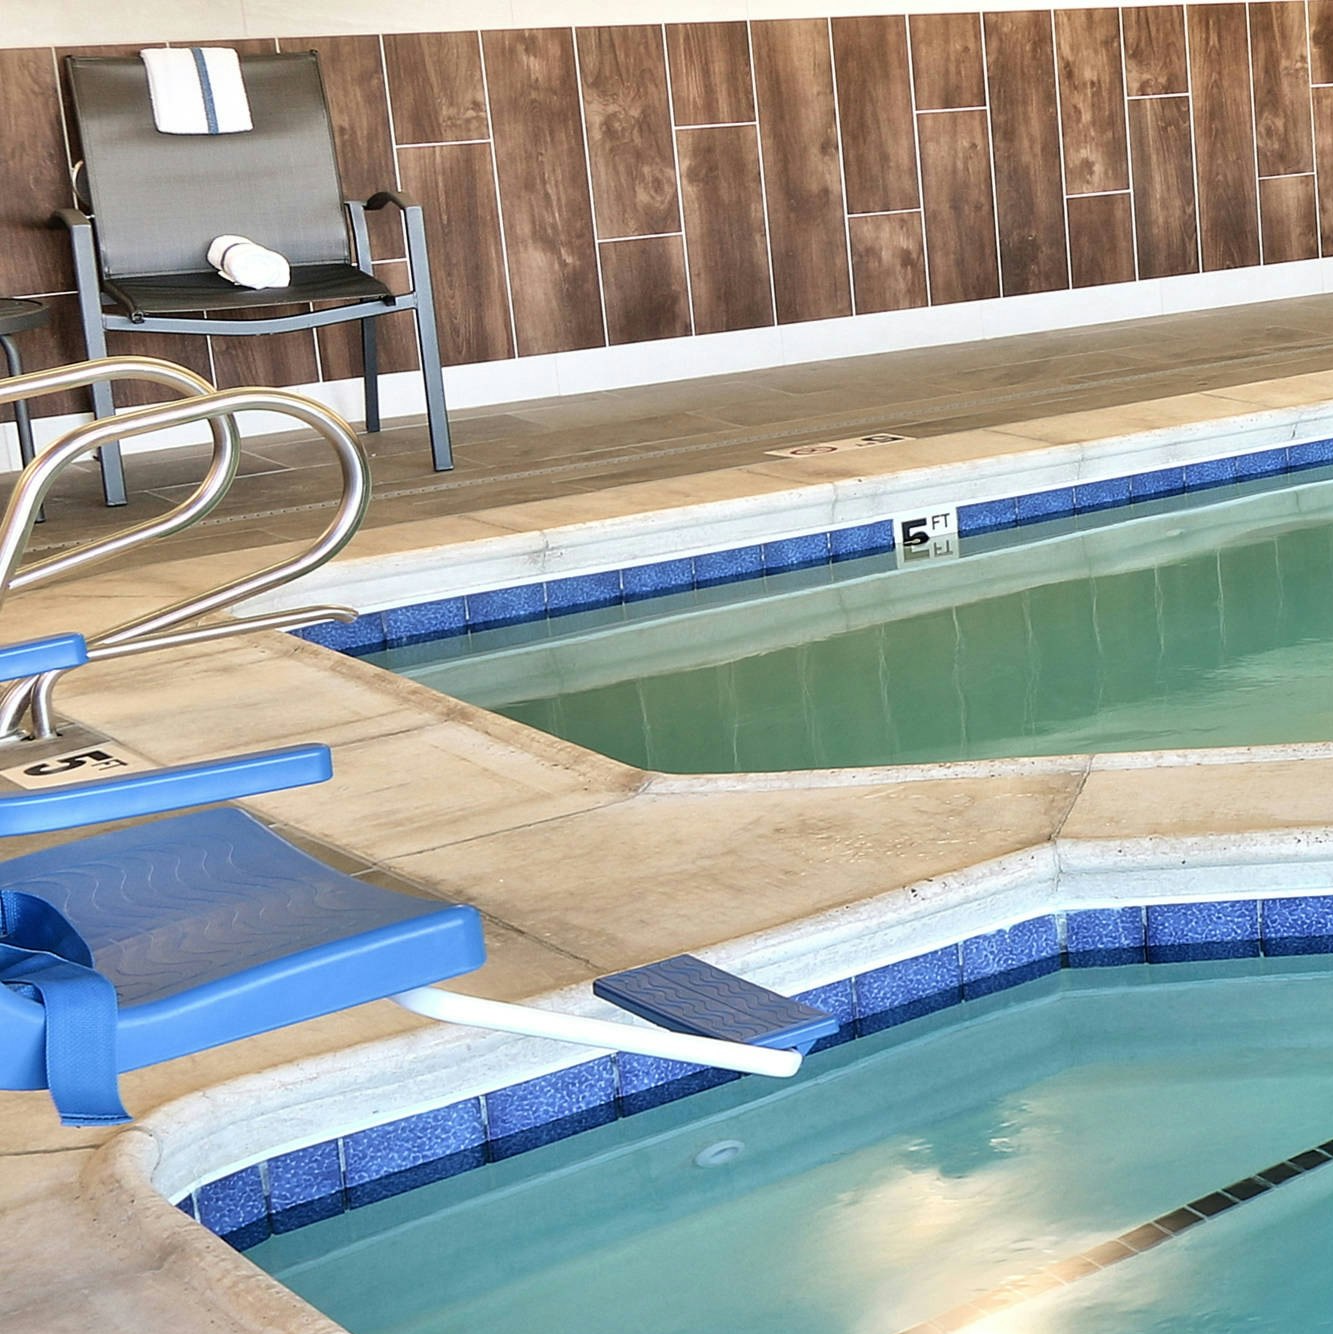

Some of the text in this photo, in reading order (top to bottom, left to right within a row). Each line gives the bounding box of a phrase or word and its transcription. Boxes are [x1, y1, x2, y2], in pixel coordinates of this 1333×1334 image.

[901, 513, 950, 546] 5 FT
[24, 750, 129, 777] 5 FT
